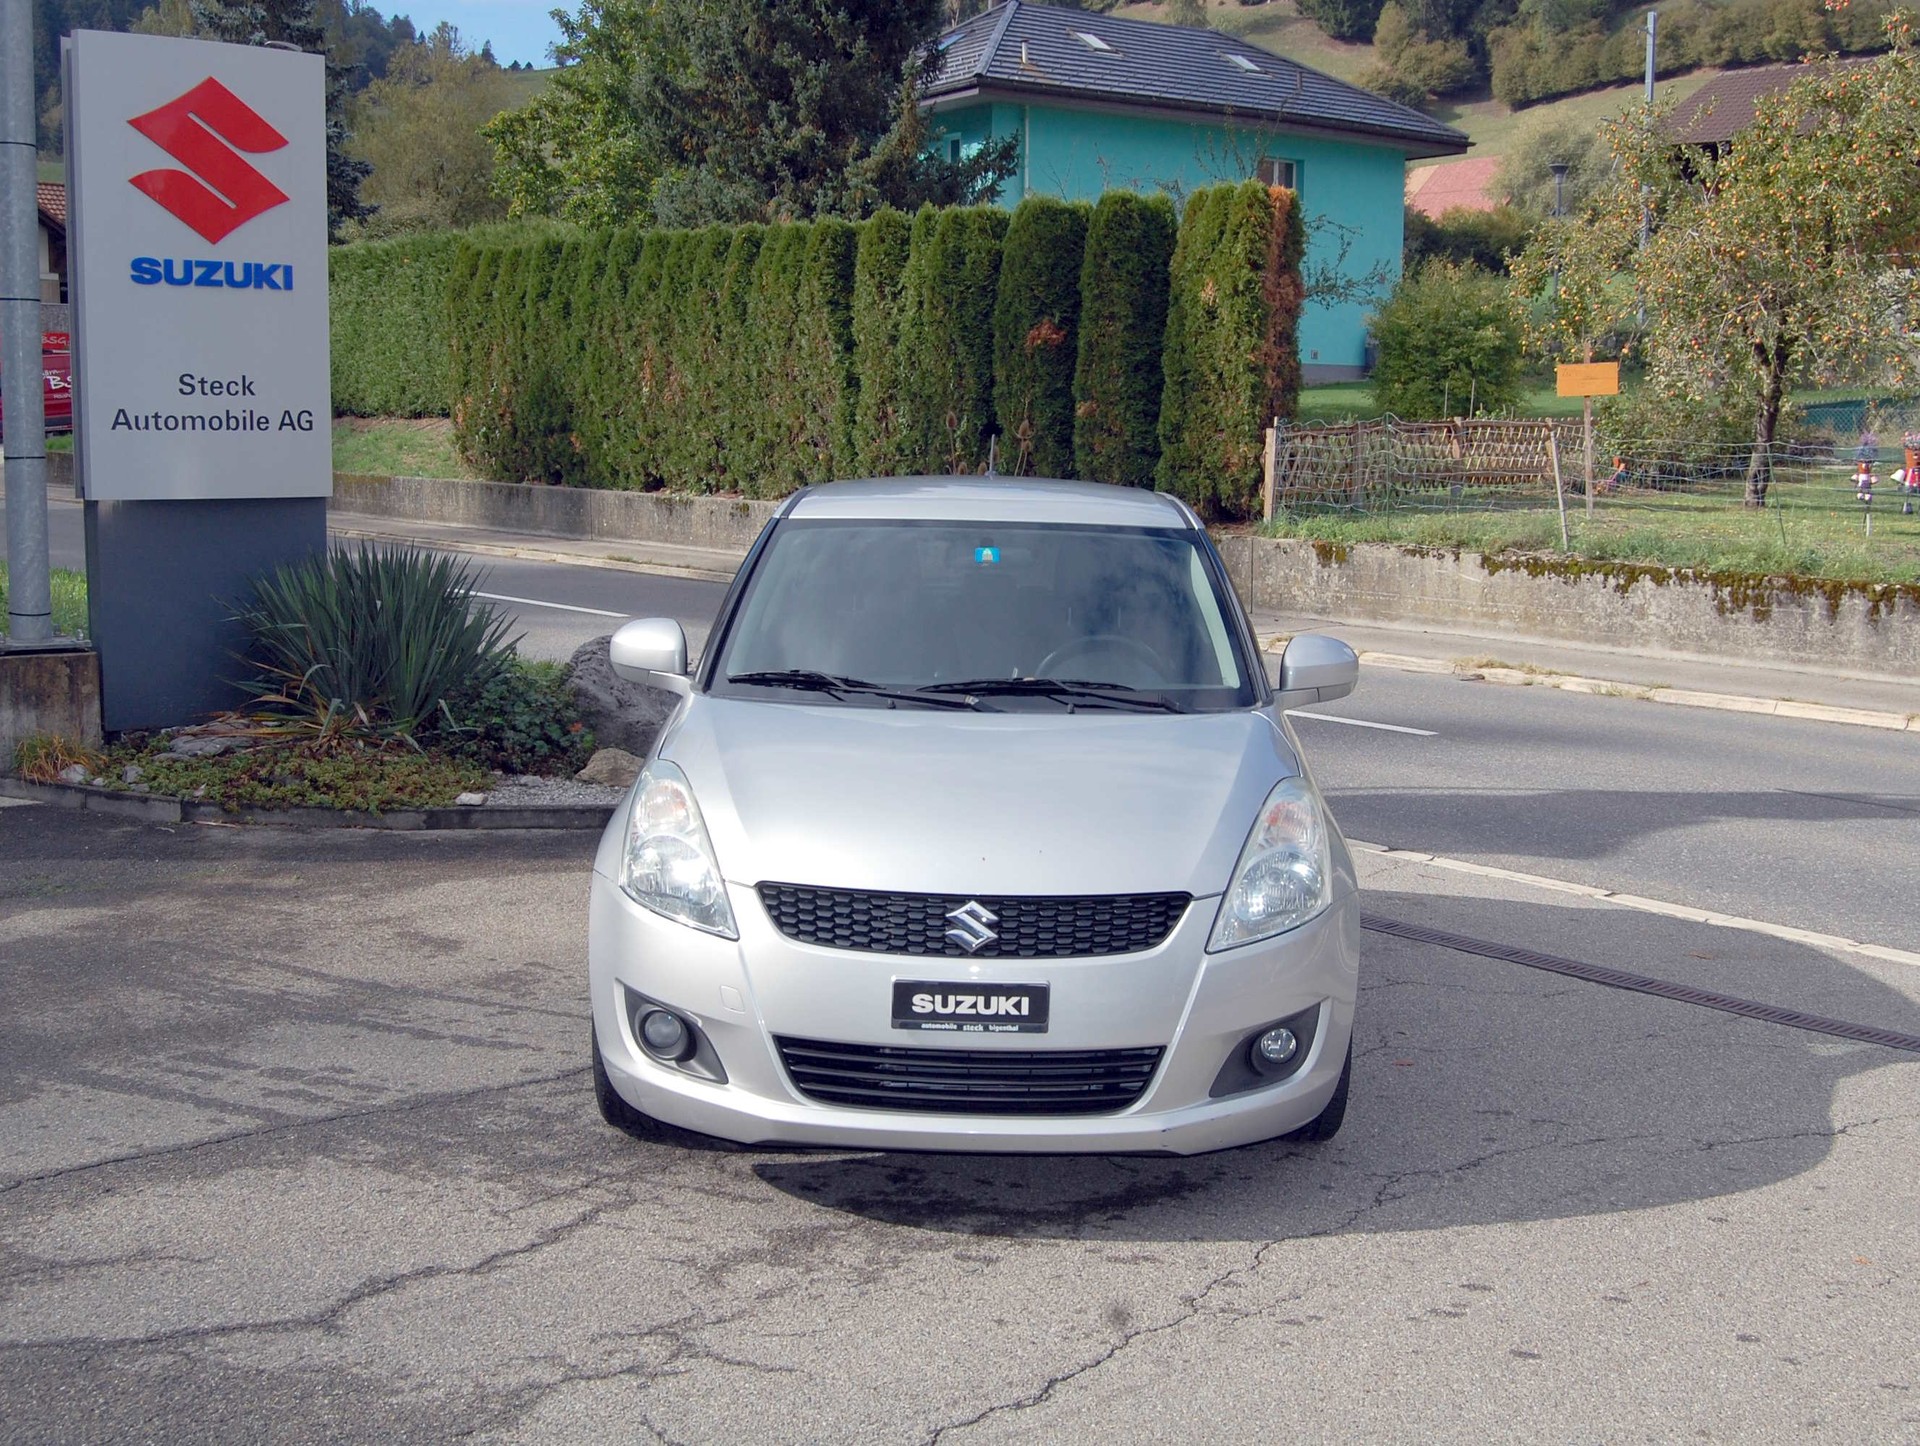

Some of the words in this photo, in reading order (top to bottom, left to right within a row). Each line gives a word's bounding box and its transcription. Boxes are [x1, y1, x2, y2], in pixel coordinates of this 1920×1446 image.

[130, 257, 294, 291] SUZUKI
[178, 373, 256, 397] Steck
[111, 408, 270, 432] Automobile
[278, 409, 314, 432] AG
[911, 993, 1030, 1016] SUZUKI
[921, 1022, 958, 1030] automobile
[962, 1023, 984, 1032] steck
